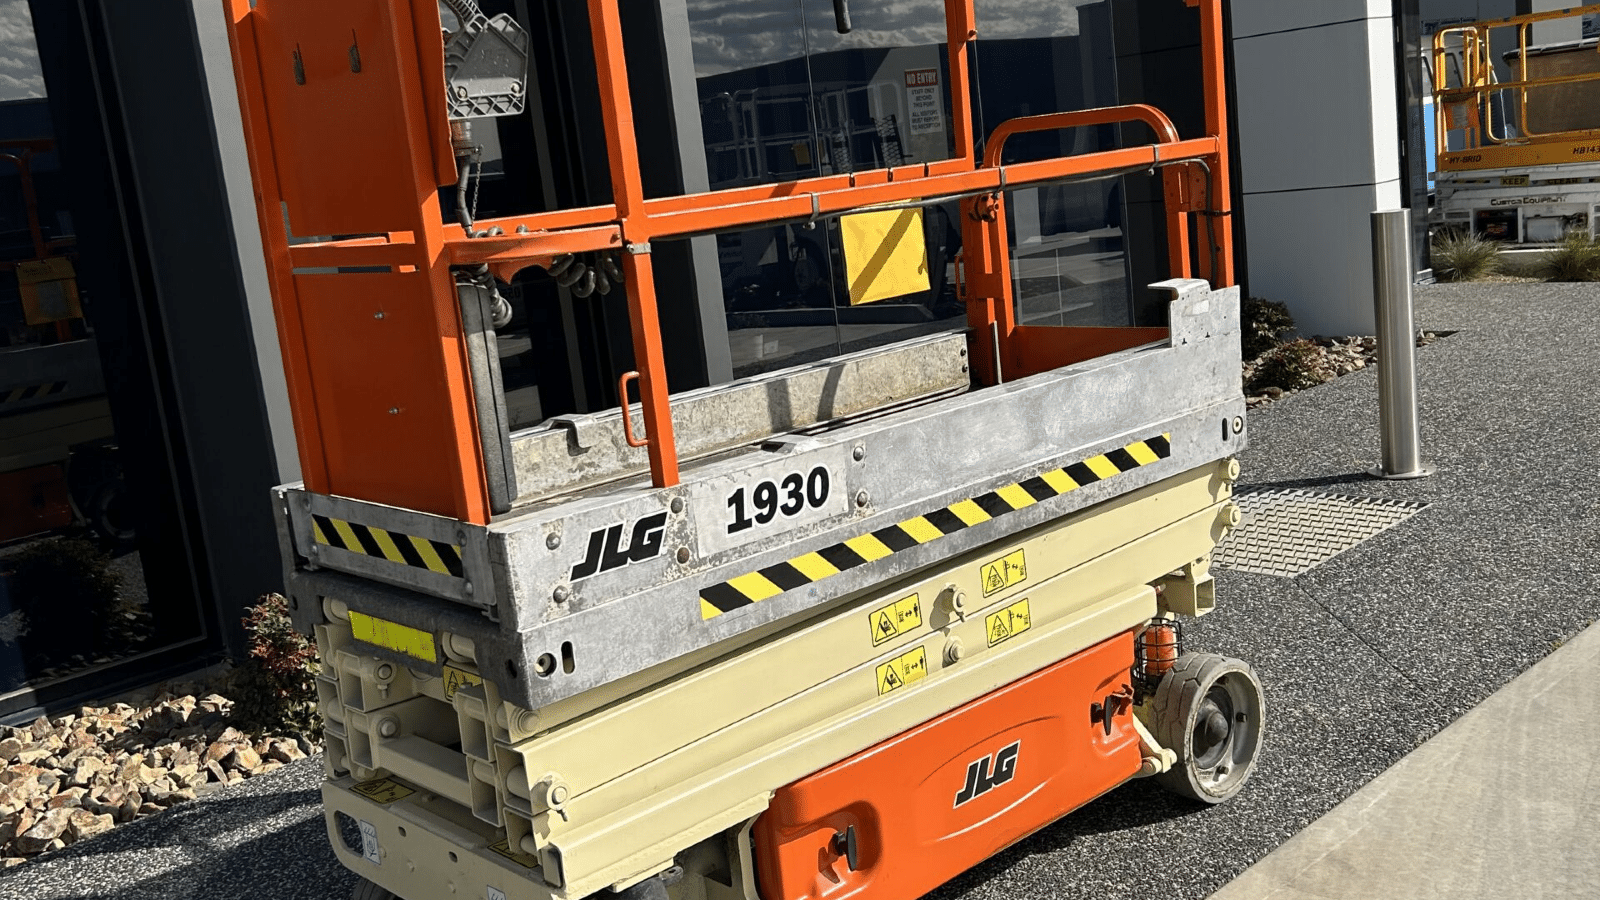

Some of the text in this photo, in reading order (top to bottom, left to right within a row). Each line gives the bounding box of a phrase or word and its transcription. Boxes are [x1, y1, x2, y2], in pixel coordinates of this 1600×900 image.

[906, 72, 936, 85] NO ENTRY
[1449, 155, 1482, 165] HY-BRID
[1502, 176, 1526, 186] KEEP
[726, 465, 830, 535] 1930
[569, 511, 668, 582] JLG
[953, 739, 1021, 809] JLG
